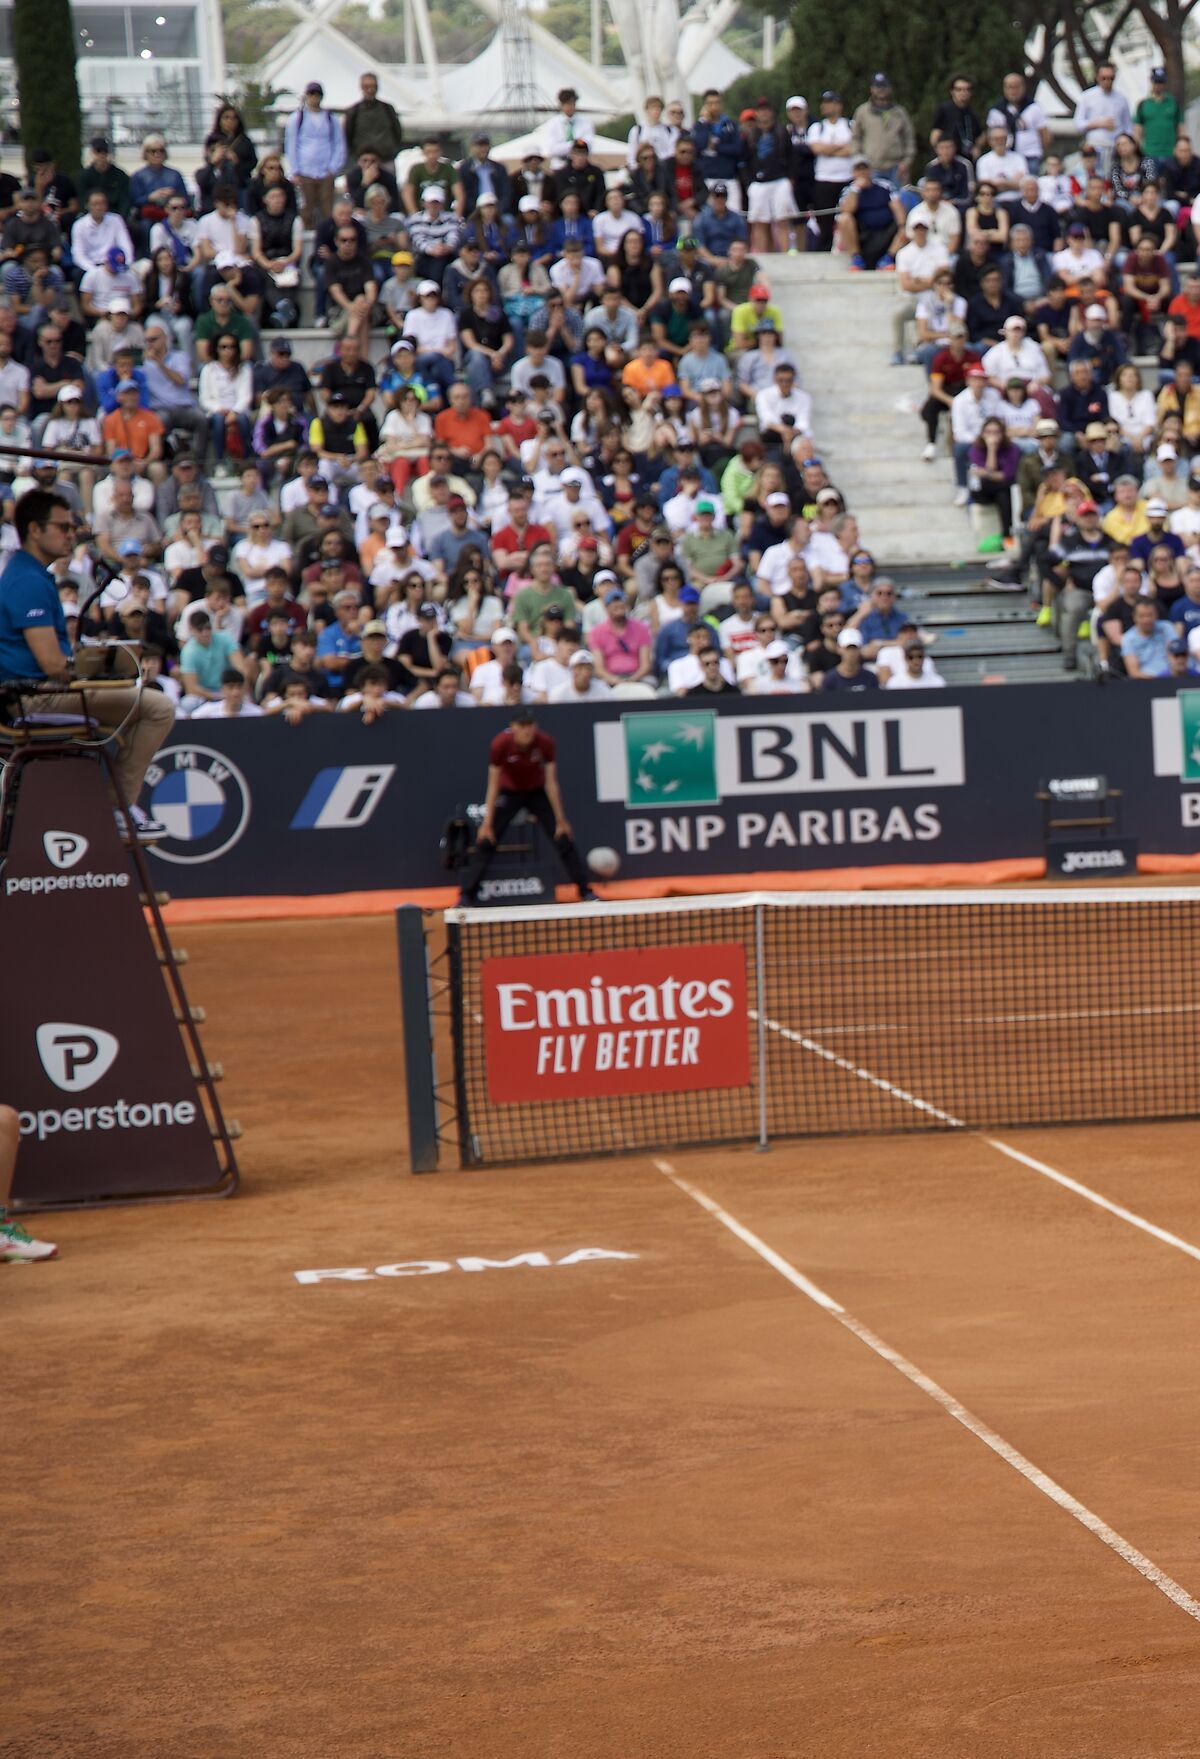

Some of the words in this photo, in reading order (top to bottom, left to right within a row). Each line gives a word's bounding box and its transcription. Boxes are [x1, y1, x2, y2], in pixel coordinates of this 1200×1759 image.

[144, 751, 231, 787] BMW
[736, 720, 937, 784] BNL
[625, 814, 727, 855] BNP
[737, 804, 942, 849] PARIBAS
[6, 871, 129, 895] pepperstone
[496, 976, 735, 1031] Emirates
[537, 1033, 587, 1075] FLY
[595, 1026, 700, 1071] BETTER
[19, 1100, 195, 1140] pperstone
[294, 1248, 641, 1284] ROMA
